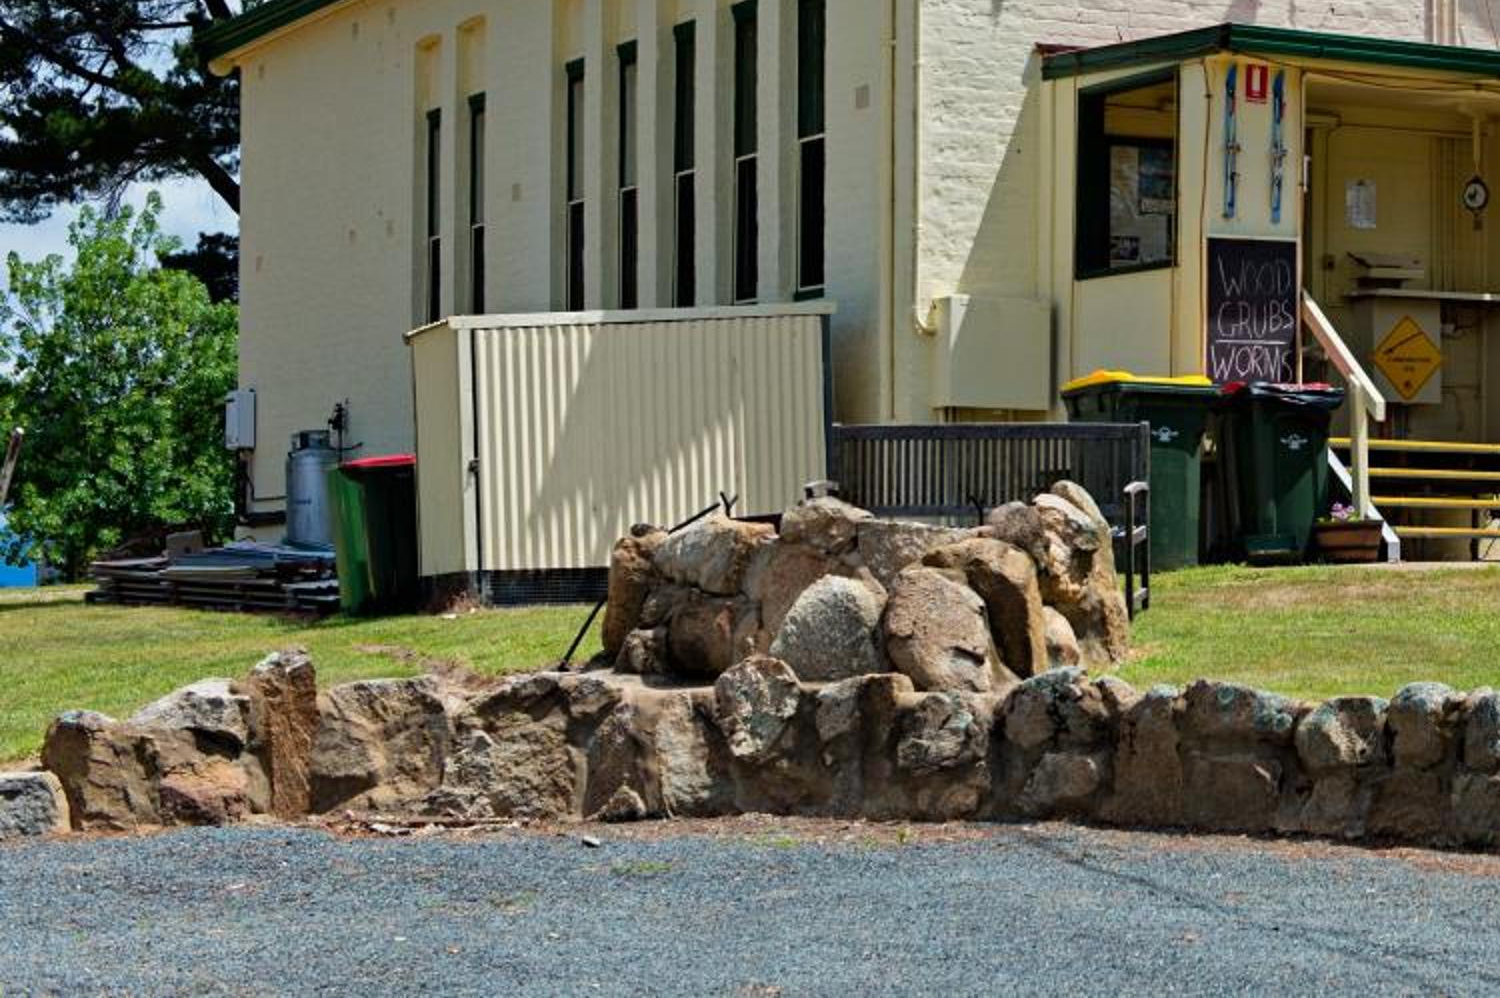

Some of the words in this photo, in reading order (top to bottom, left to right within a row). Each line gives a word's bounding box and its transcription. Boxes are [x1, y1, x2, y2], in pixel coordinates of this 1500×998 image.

[1217, 253, 1291, 297] WOOD
[1217, 299, 1295, 339] GRUBS
[1211, 345, 1293, 383] WORMS
